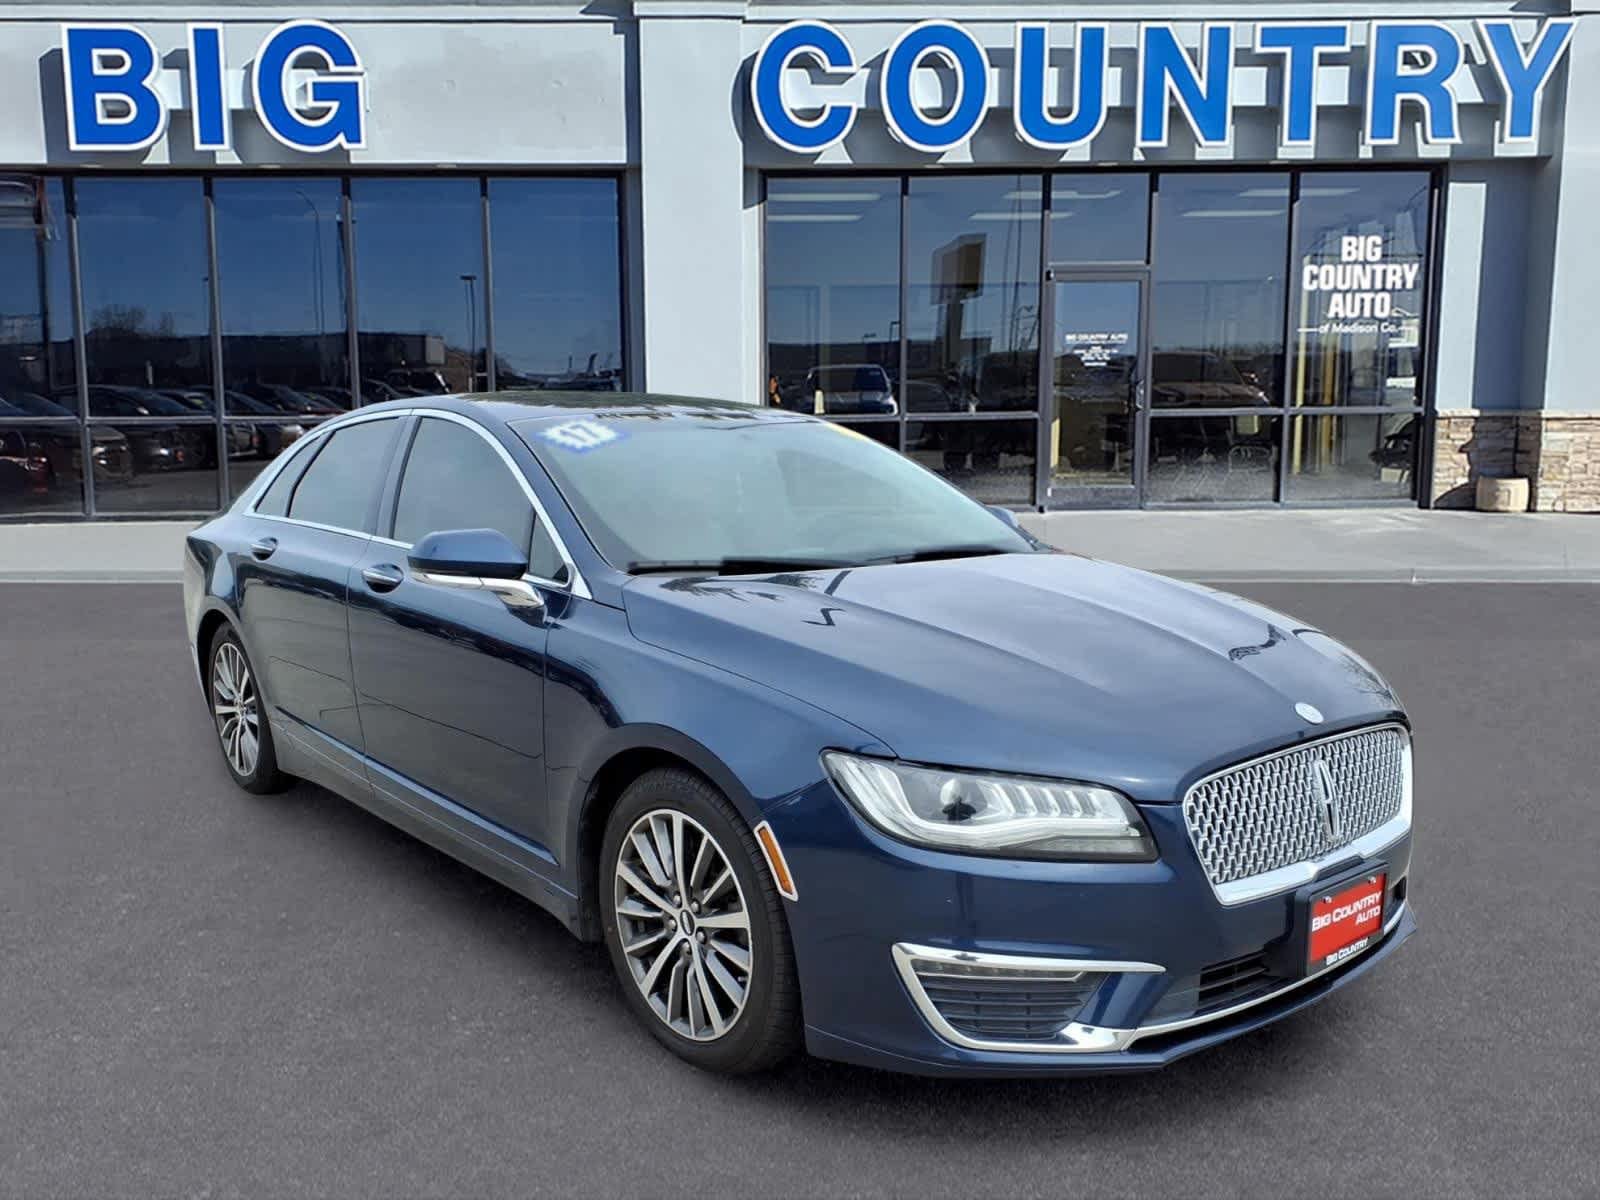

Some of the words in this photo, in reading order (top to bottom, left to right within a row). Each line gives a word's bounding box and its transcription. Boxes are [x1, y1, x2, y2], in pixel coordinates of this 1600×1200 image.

[60, 19, 367, 153] BIG
[751, 18, 1575, 154] COUNTRY
[1341, 235, 1382, 261] BIG
[1302, 264, 1419, 290] COUNTRY
[1327, 292, 1391, 318] AUTO
[1331, 322, 1378, 334] Madison
[1332, 891, 1382, 921] COUNTRY
[1355, 905, 1381, 926] AUTO
[1338, 938, 1369, 960] COUNTRY
